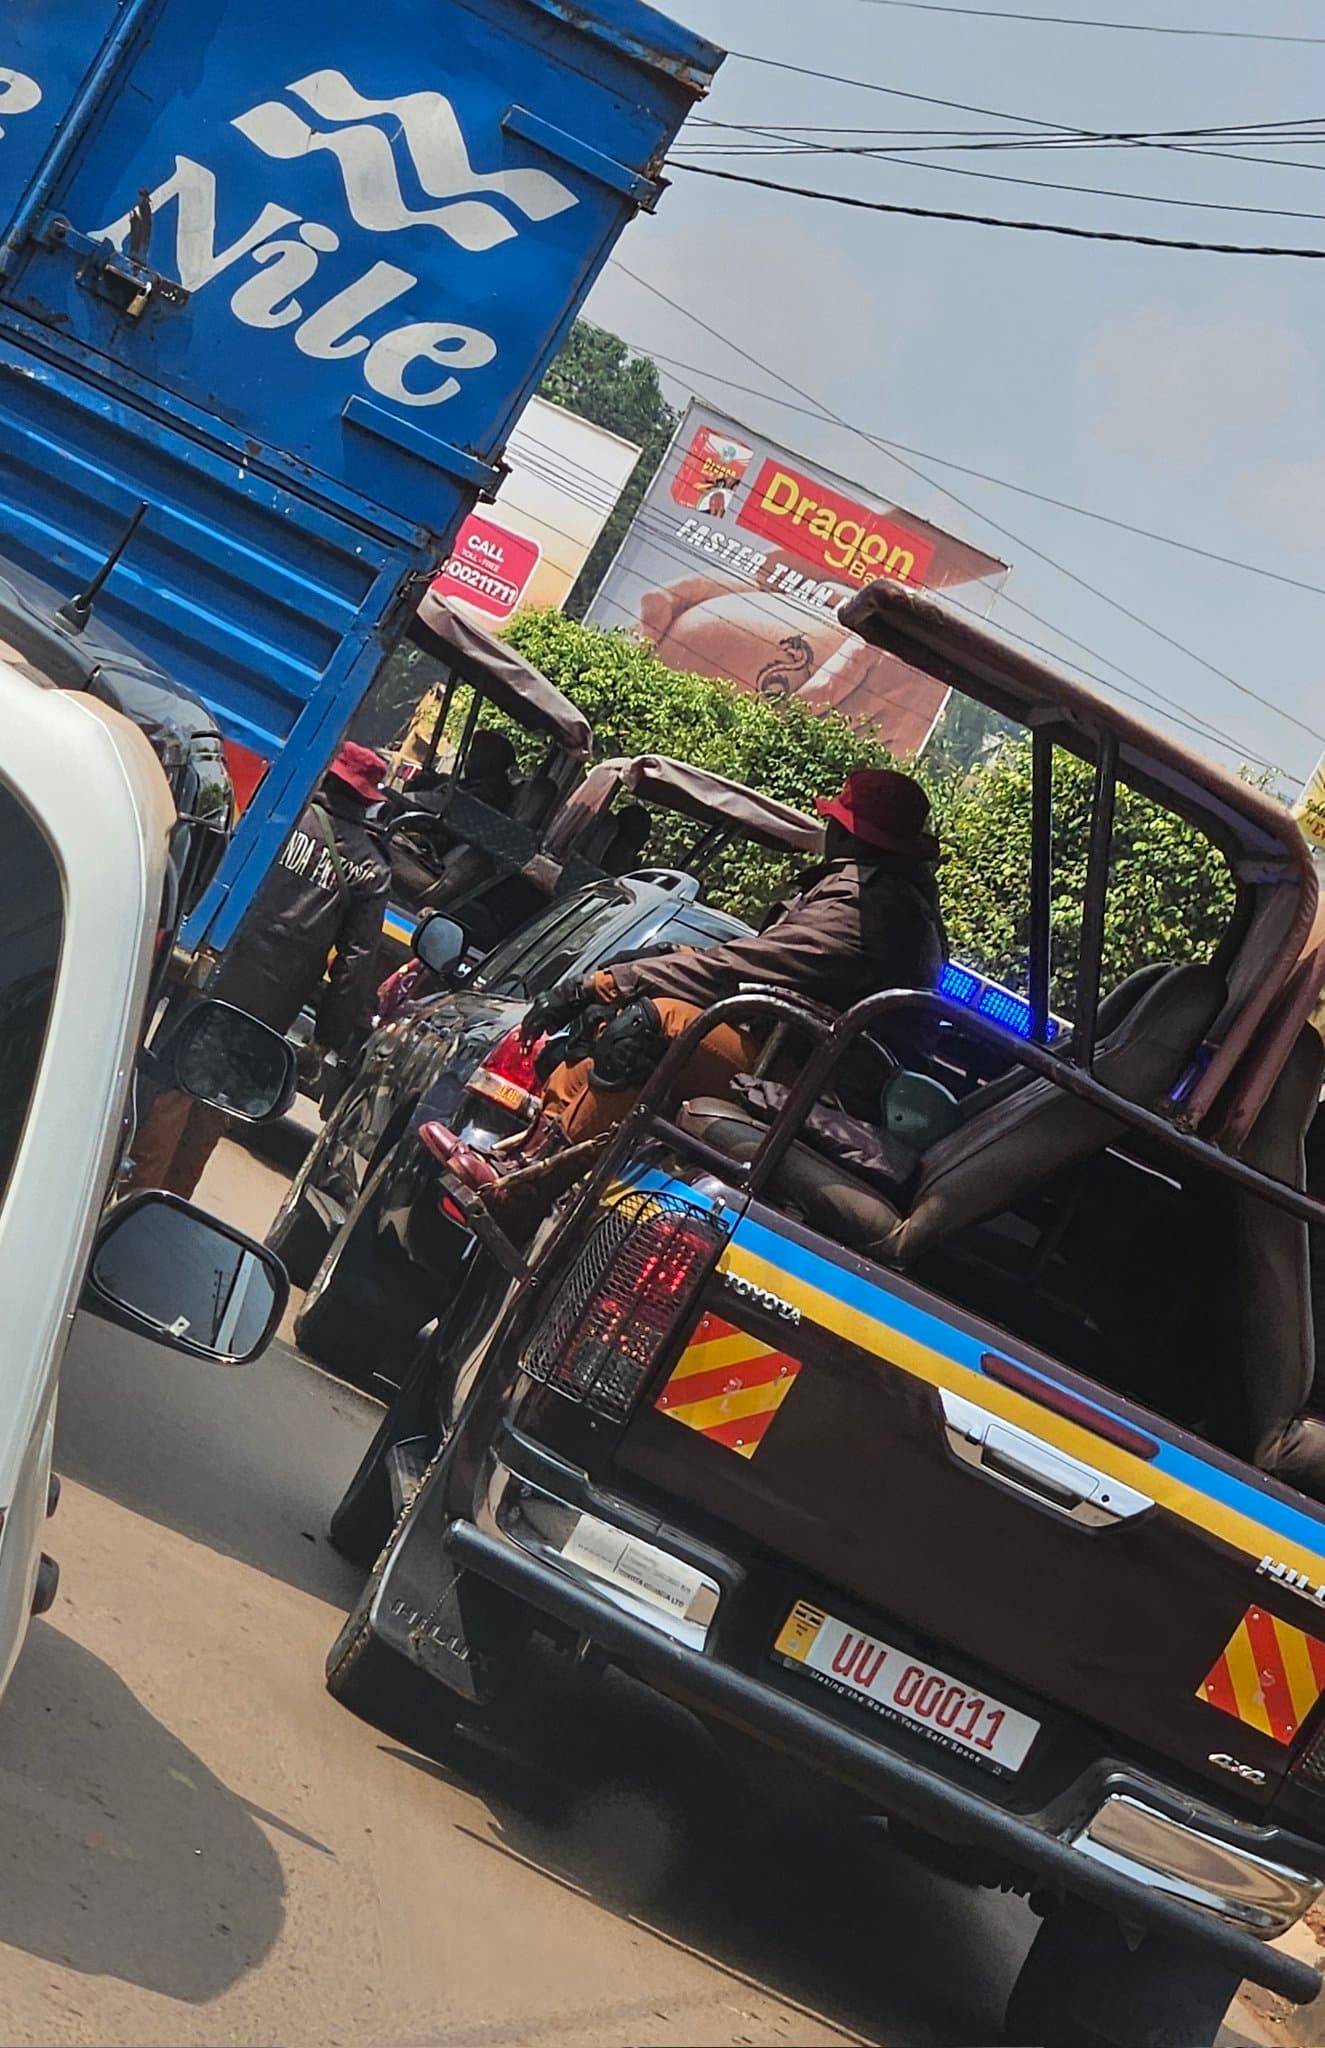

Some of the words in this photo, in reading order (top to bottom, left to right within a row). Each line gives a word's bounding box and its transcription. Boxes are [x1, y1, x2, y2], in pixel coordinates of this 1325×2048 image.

[86, 154, 497, 406] Nile
[461, 547, 479, 562] TOLL
[482, 558, 501, 573] FREE
[467, 534, 505, 563] CALL
[676, 519, 767, 575] FASTER
[766, 563, 833, 608] THAN
[760, 471, 915, 581] Dragon
[724, 1269, 801, 1327] TOYOTA
[808, 1670, 845, 1695] Making
[847, 1688, 865, 1703] the
[866, 1699, 897, 1720] Roads
[901, 1716, 924, 1735] Your
[925, 1729, 948, 1746] Safe
[950, 1742, 982, 1763] Space
[892, 1664, 1006, 1752] 00011
